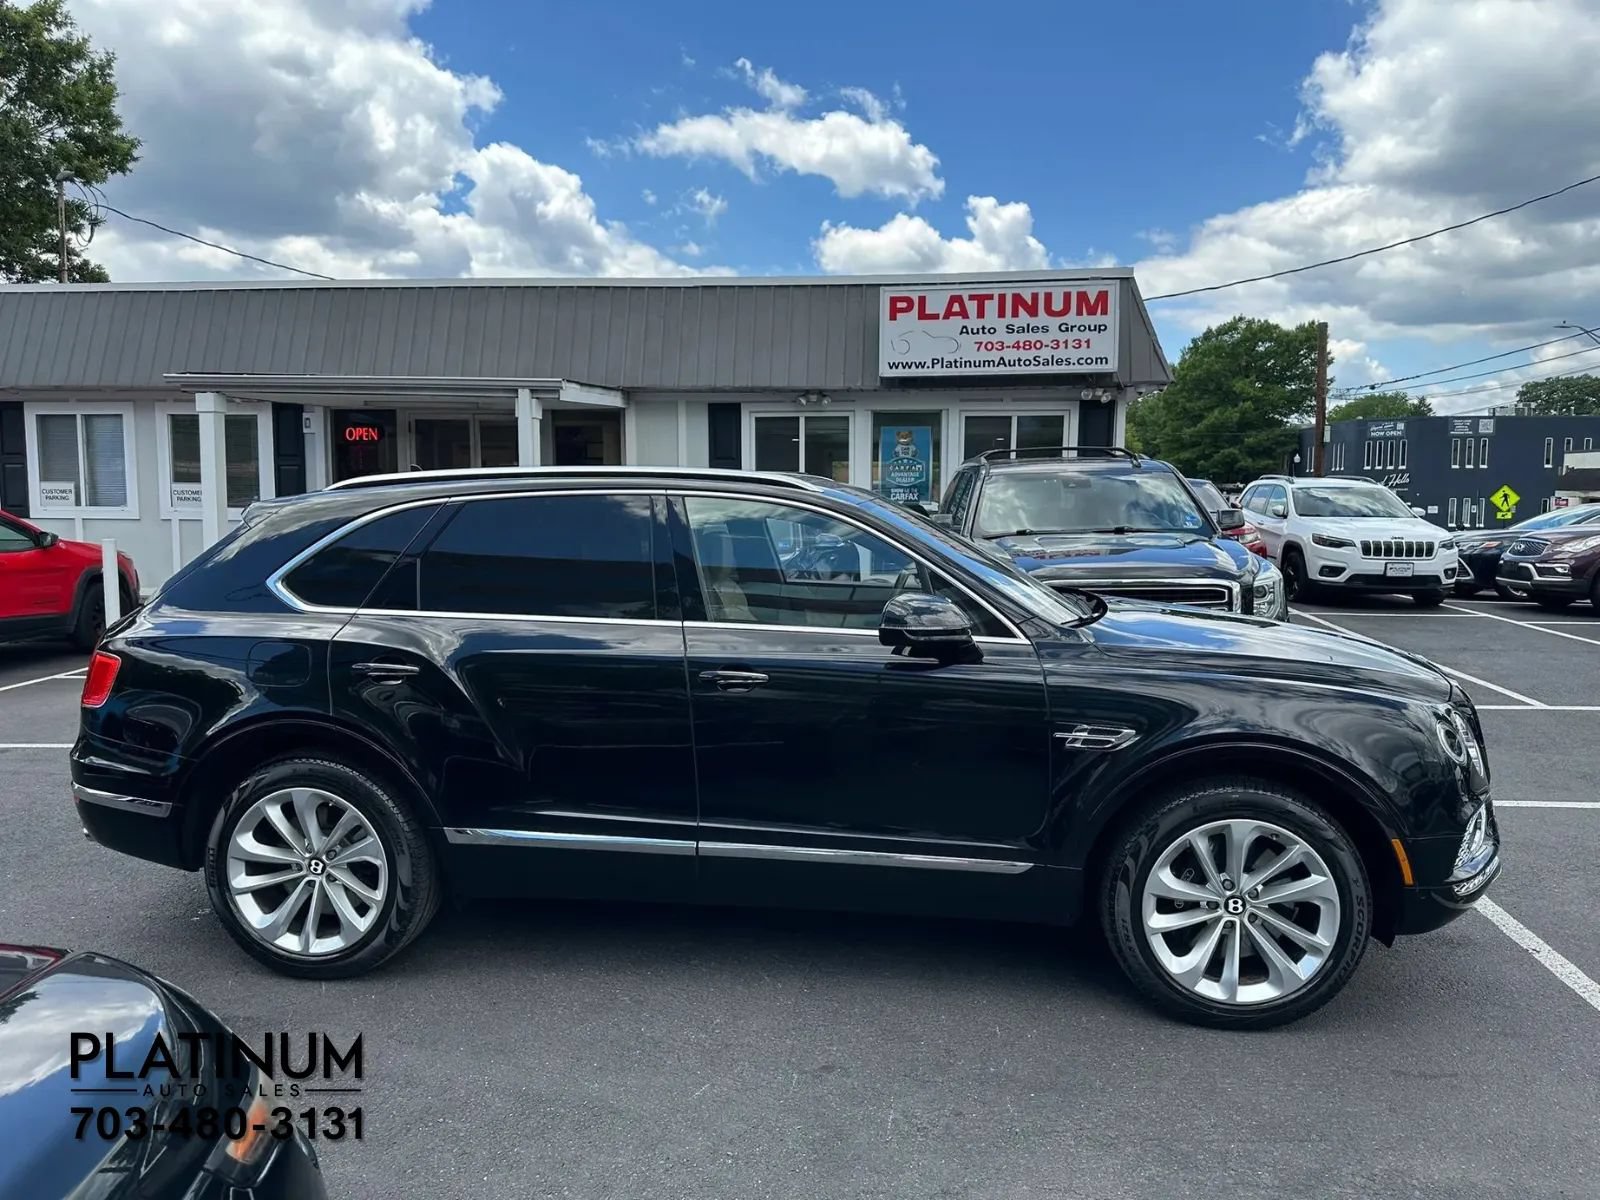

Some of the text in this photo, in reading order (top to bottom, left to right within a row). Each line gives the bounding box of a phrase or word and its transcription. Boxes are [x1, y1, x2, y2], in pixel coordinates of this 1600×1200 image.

[888, 290, 1109, 321] PLATINUM
[959, 322, 1108, 336] Auto Sales Group
[974, 338, 1092, 352] 703-480-3131
[887, 356, 1109, 370] www.PlatinumAutoSales.com
[346, 427, 378, 441] OPEN
[890, 493, 918, 501] CARFAX
